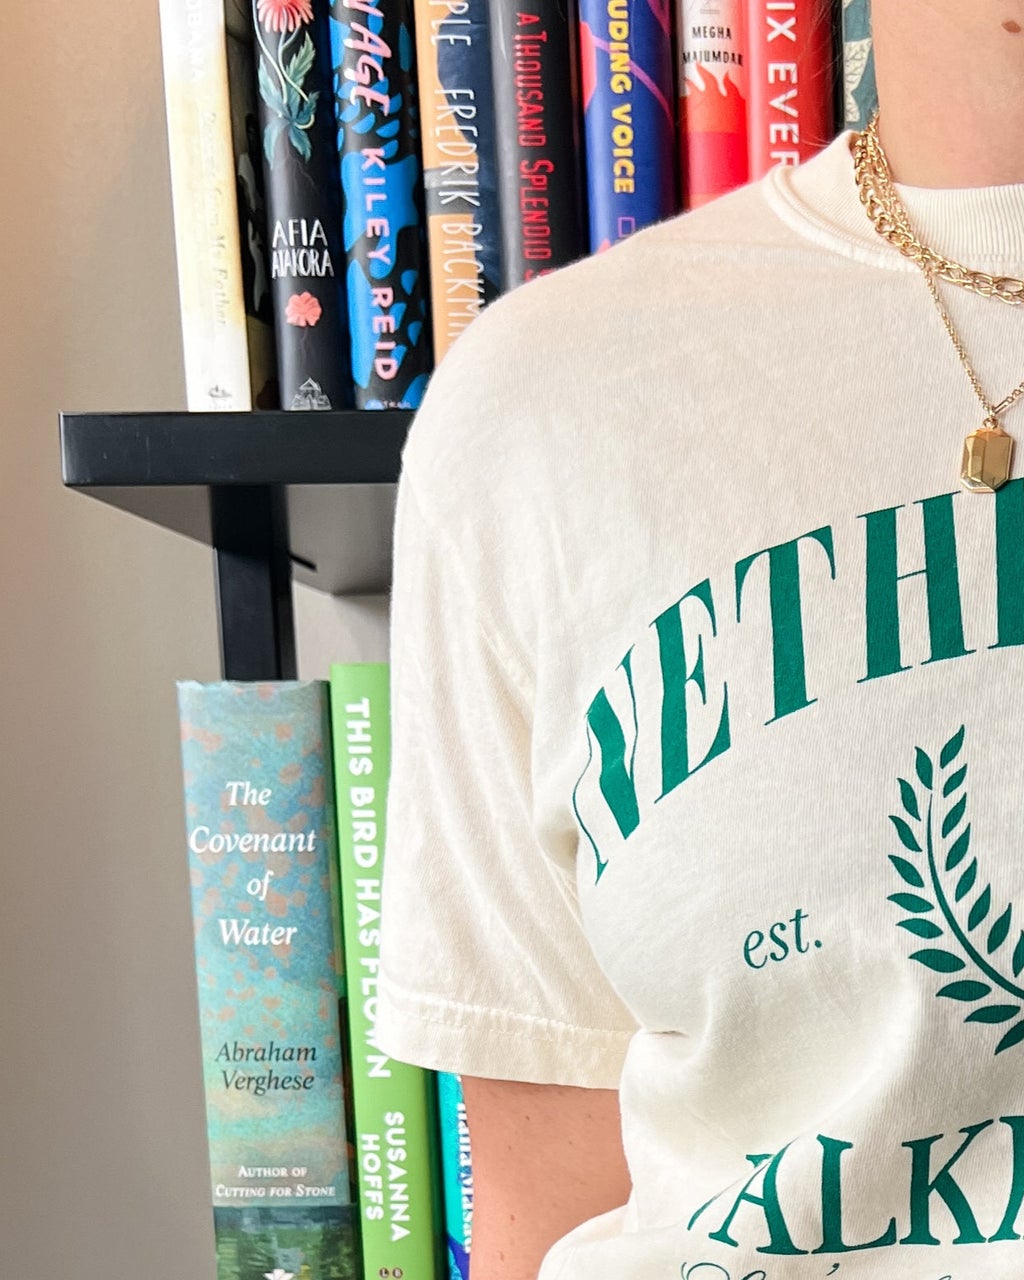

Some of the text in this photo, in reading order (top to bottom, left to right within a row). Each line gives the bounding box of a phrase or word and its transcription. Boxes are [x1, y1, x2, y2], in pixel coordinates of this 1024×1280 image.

[516, 12, 540, 26] A
[692, 26, 732, 40] MEGHA
[343, 21, 392, 117] AGE
[512, 31, 548, 148] THOUSAND
[608, 0, 636, 194] UDING VOICE
[272, 218, 328, 248] AFIA
[360, 147, 391, 267] KILEY
[434, 88, 485, 338] FREDRIK BACKM
[519, 158, 554, 261] SPLENDID
[370, 287, 398, 381] REID
[345, 697, 375, 776] THIS
[225, 781, 272, 806] The
[350, 787, 379, 868] BIRD
[189, 826, 316, 853] Covenant
[246, 871, 274, 901] of
[355, 879, 382, 947] HAS
[217, 918, 298, 946] Water
[743, 908, 822, 969] est.
[215, 1041, 317, 1062] Abraham
[220, 1069, 315, 1097] Verghese
[362, 1134, 385, 1221] HOFFS
[385, 1111, 411, 1242] SUSANNA
